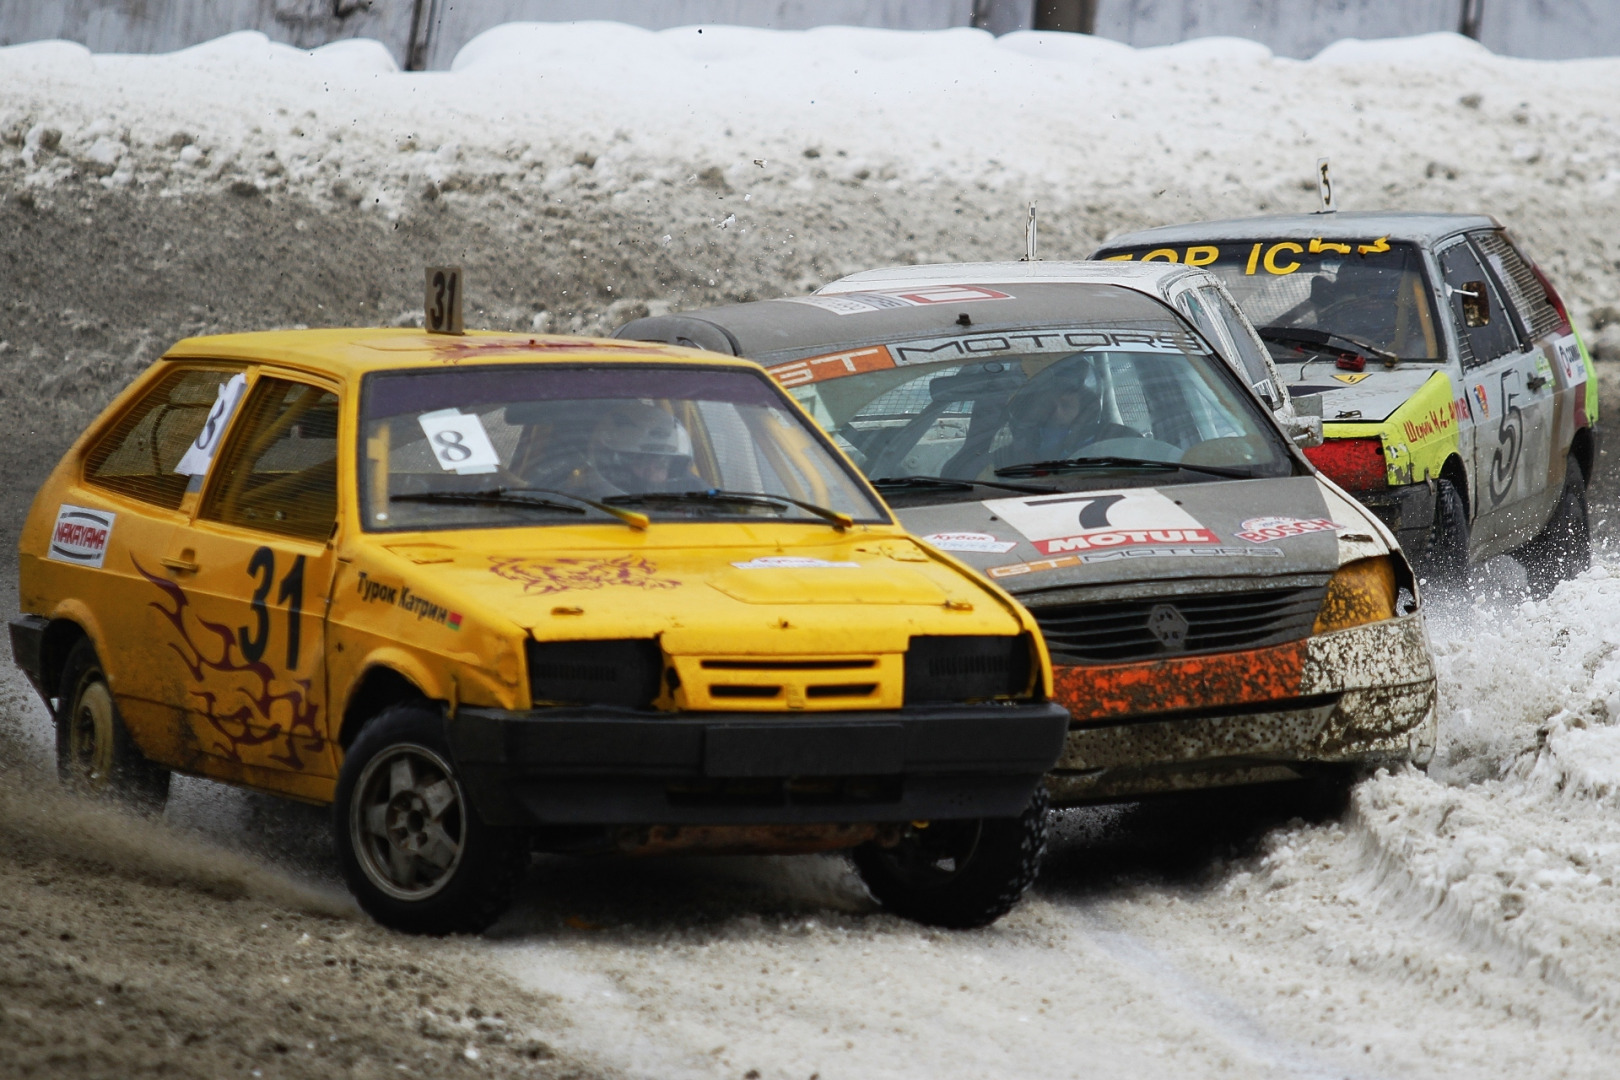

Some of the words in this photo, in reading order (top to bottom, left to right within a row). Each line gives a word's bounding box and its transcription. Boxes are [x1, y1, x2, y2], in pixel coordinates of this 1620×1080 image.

[430, 271, 457, 331] 31
[896, 333, 1198, 361] MOTORS
[433, 430, 472, 462] 8
[1489, 368, 1523, 505] 5
[1023, 495, 1126, 529] 7
[54, 522, 107, 550] NAKAYAMA
[1048, 531, 1209, 553] MOTUL
[1241, 519, 1341, 541] BOSCH
[1084, 548, 1281, 562] MOTORS
[238, 546, 306, 671] 31
[357, 570, 397, 605] Турок
[398, 585, 448, 625] Катрин
